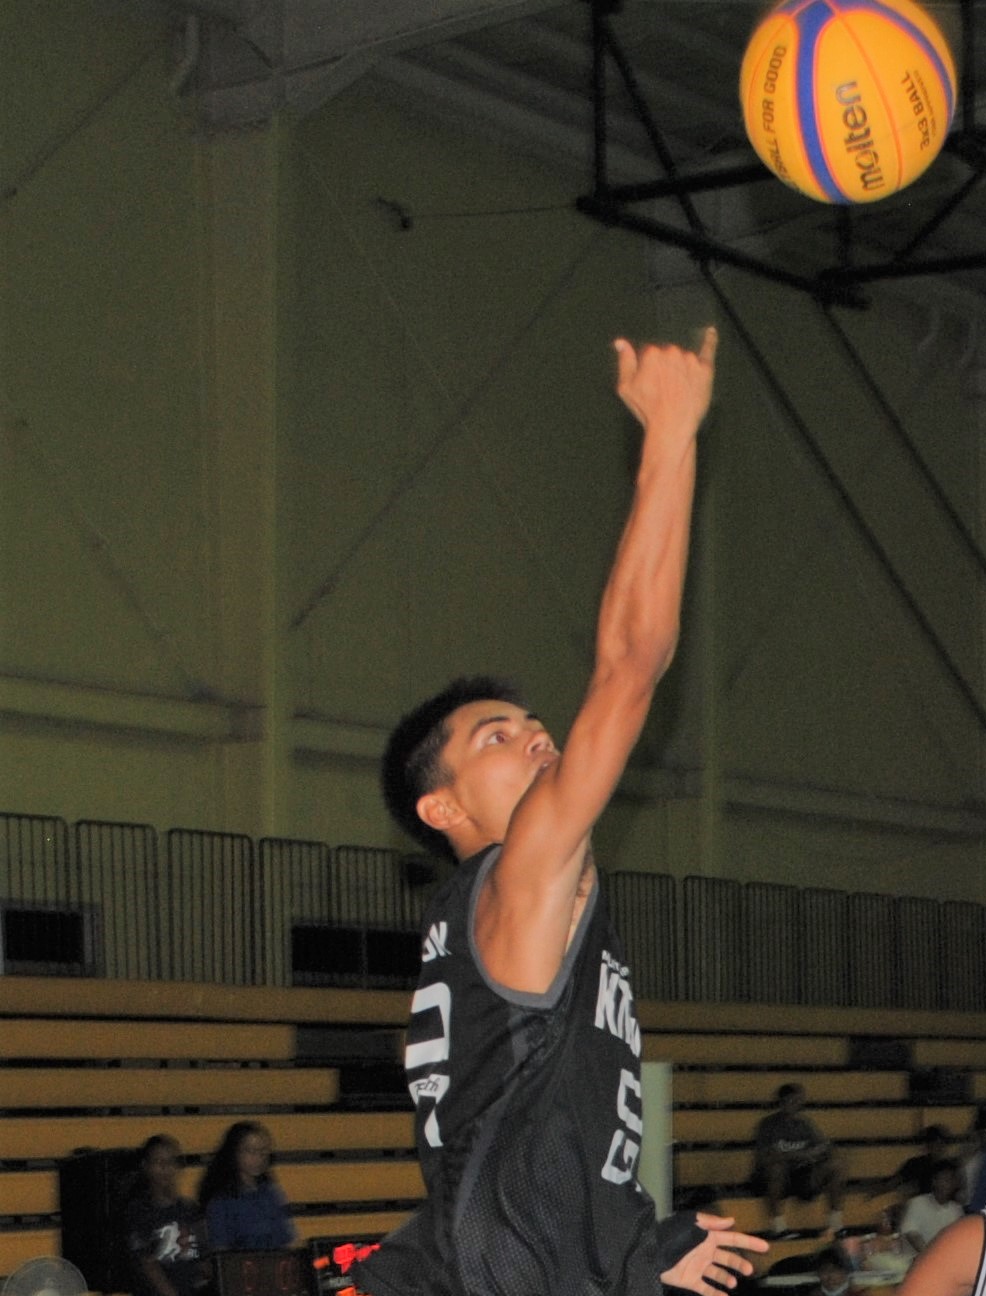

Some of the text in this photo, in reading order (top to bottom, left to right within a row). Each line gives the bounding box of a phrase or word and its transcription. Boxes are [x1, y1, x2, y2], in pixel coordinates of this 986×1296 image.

[763, 45, 787, 94] GOOD
[900, 69, 924, 116] BALL
[762, 98, 776, 134] FOR
[836, 80, 885, 191] molten
